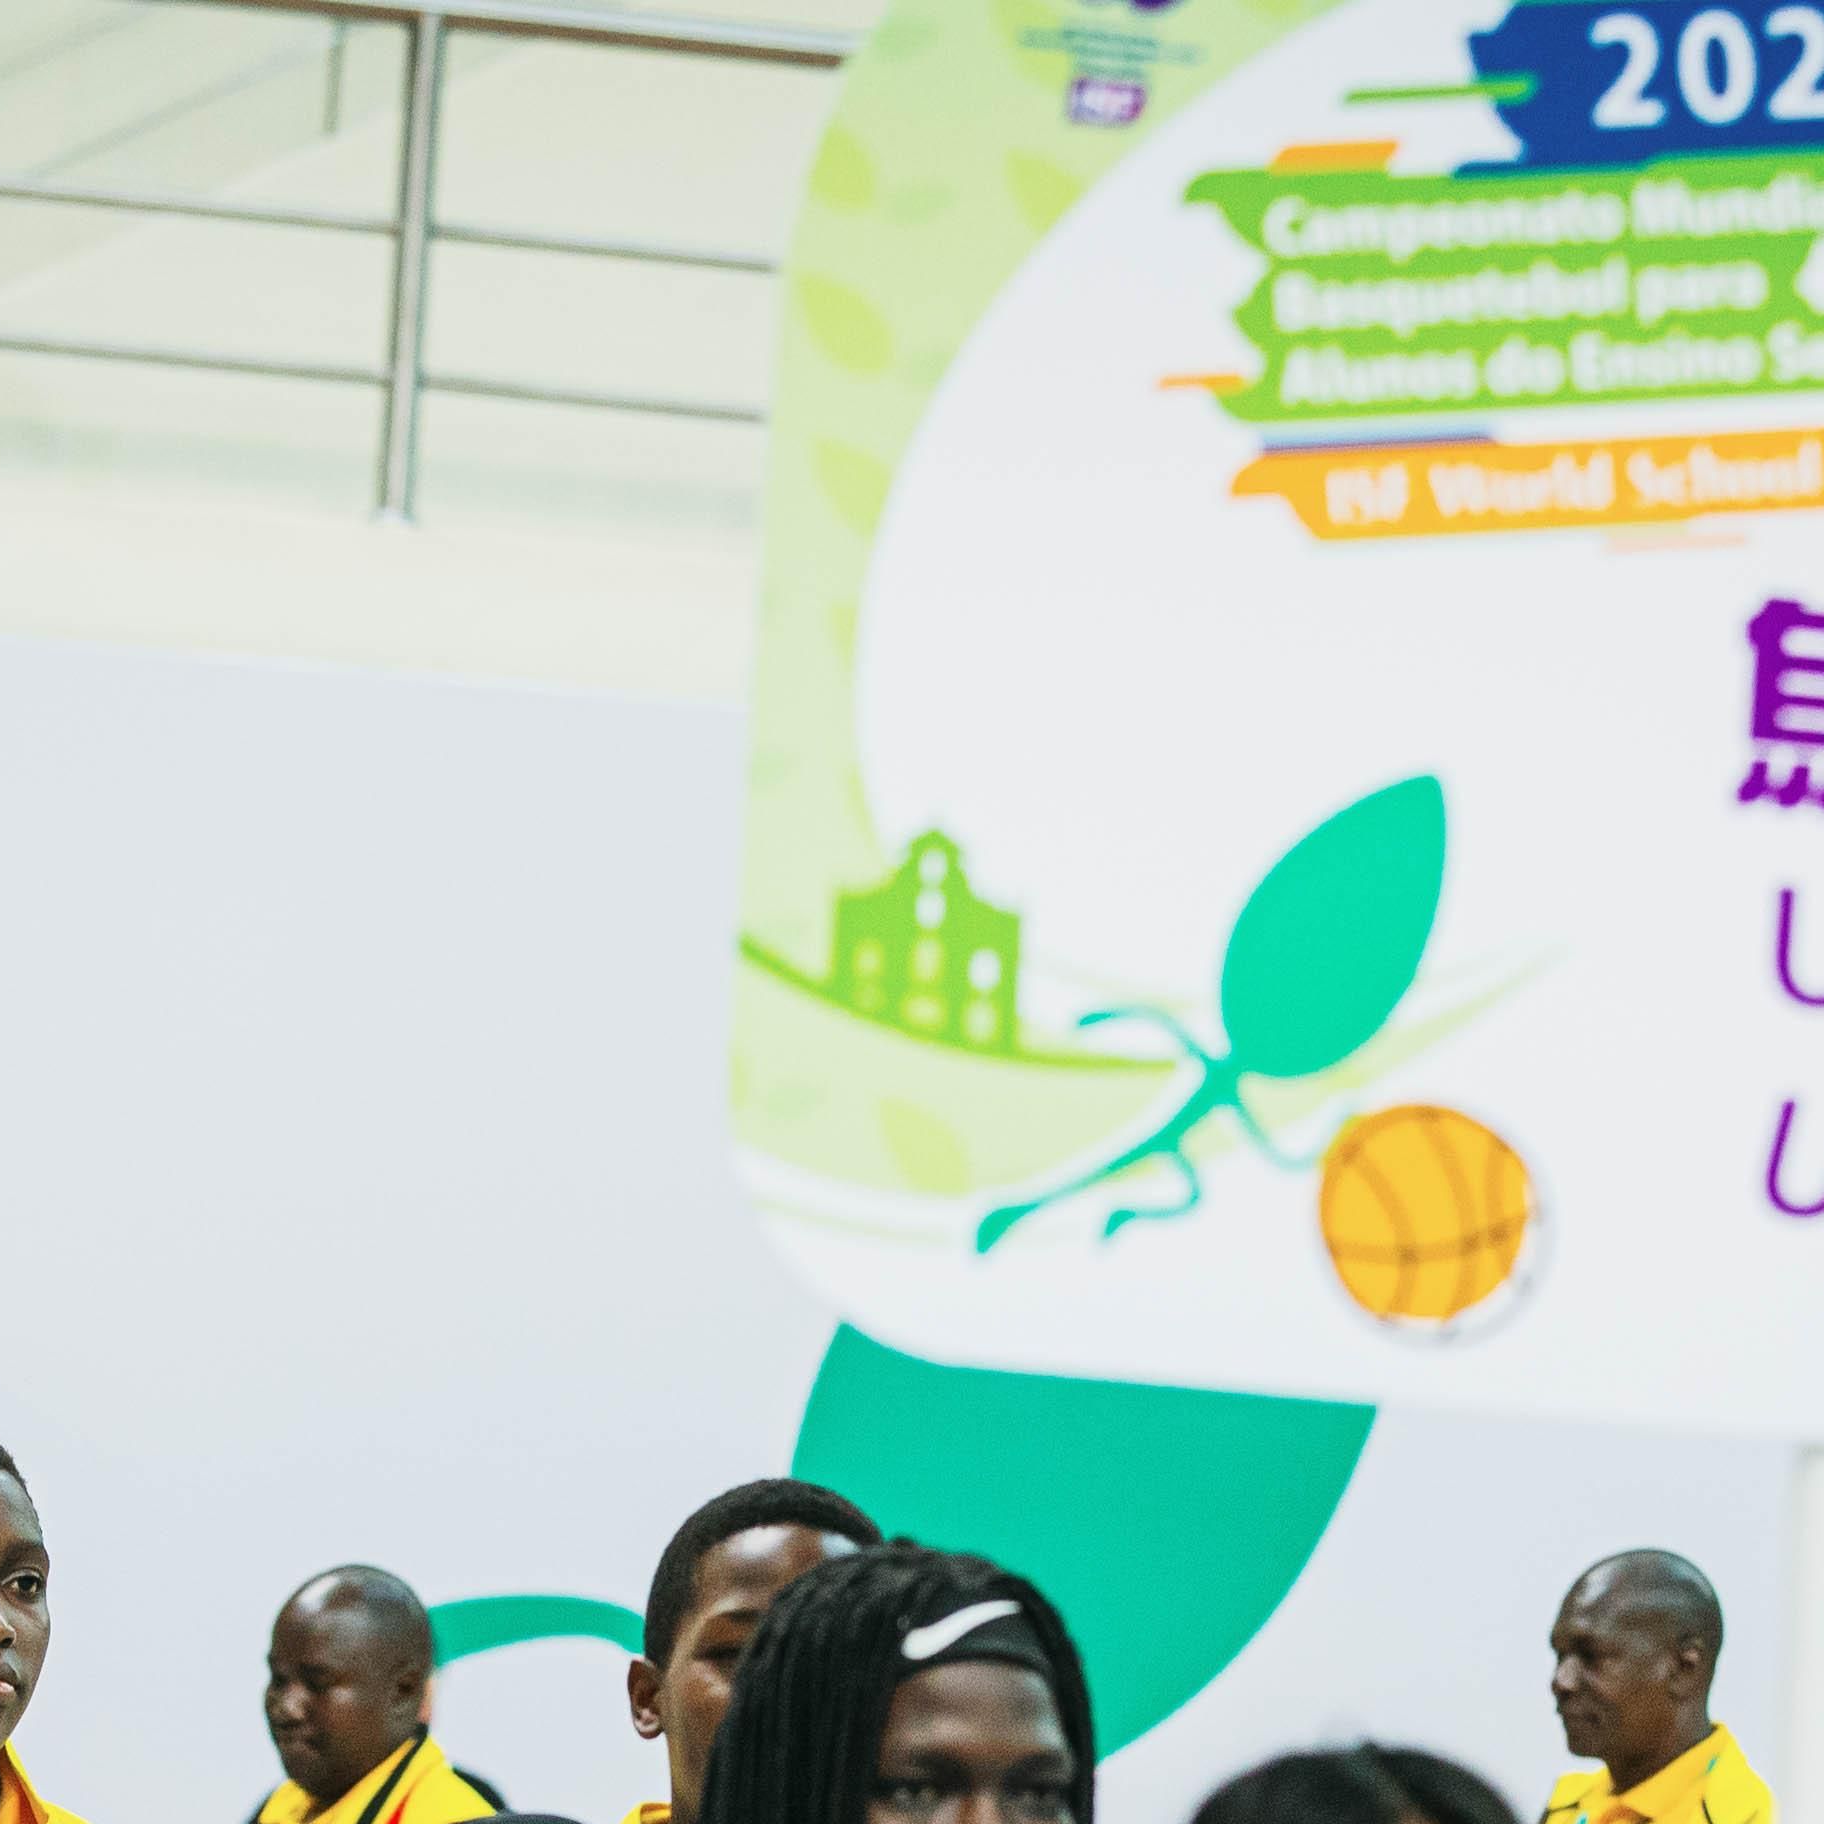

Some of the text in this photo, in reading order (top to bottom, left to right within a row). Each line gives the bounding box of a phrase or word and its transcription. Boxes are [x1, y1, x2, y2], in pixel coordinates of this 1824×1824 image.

[1263, 190, 1628, 262] Campeonato
[1275, 256, 1769, 338] Basquetebol para
[1281, 346, 1476, 403] Alunos
[1485, 336, 1565, 396] do
[1570, 331, 1764, 391] Ensino
[1325, 463, 1410, 524] ISF
[1428, 450, 1616, 519] World
[1627, 438, 1824, 507] School
